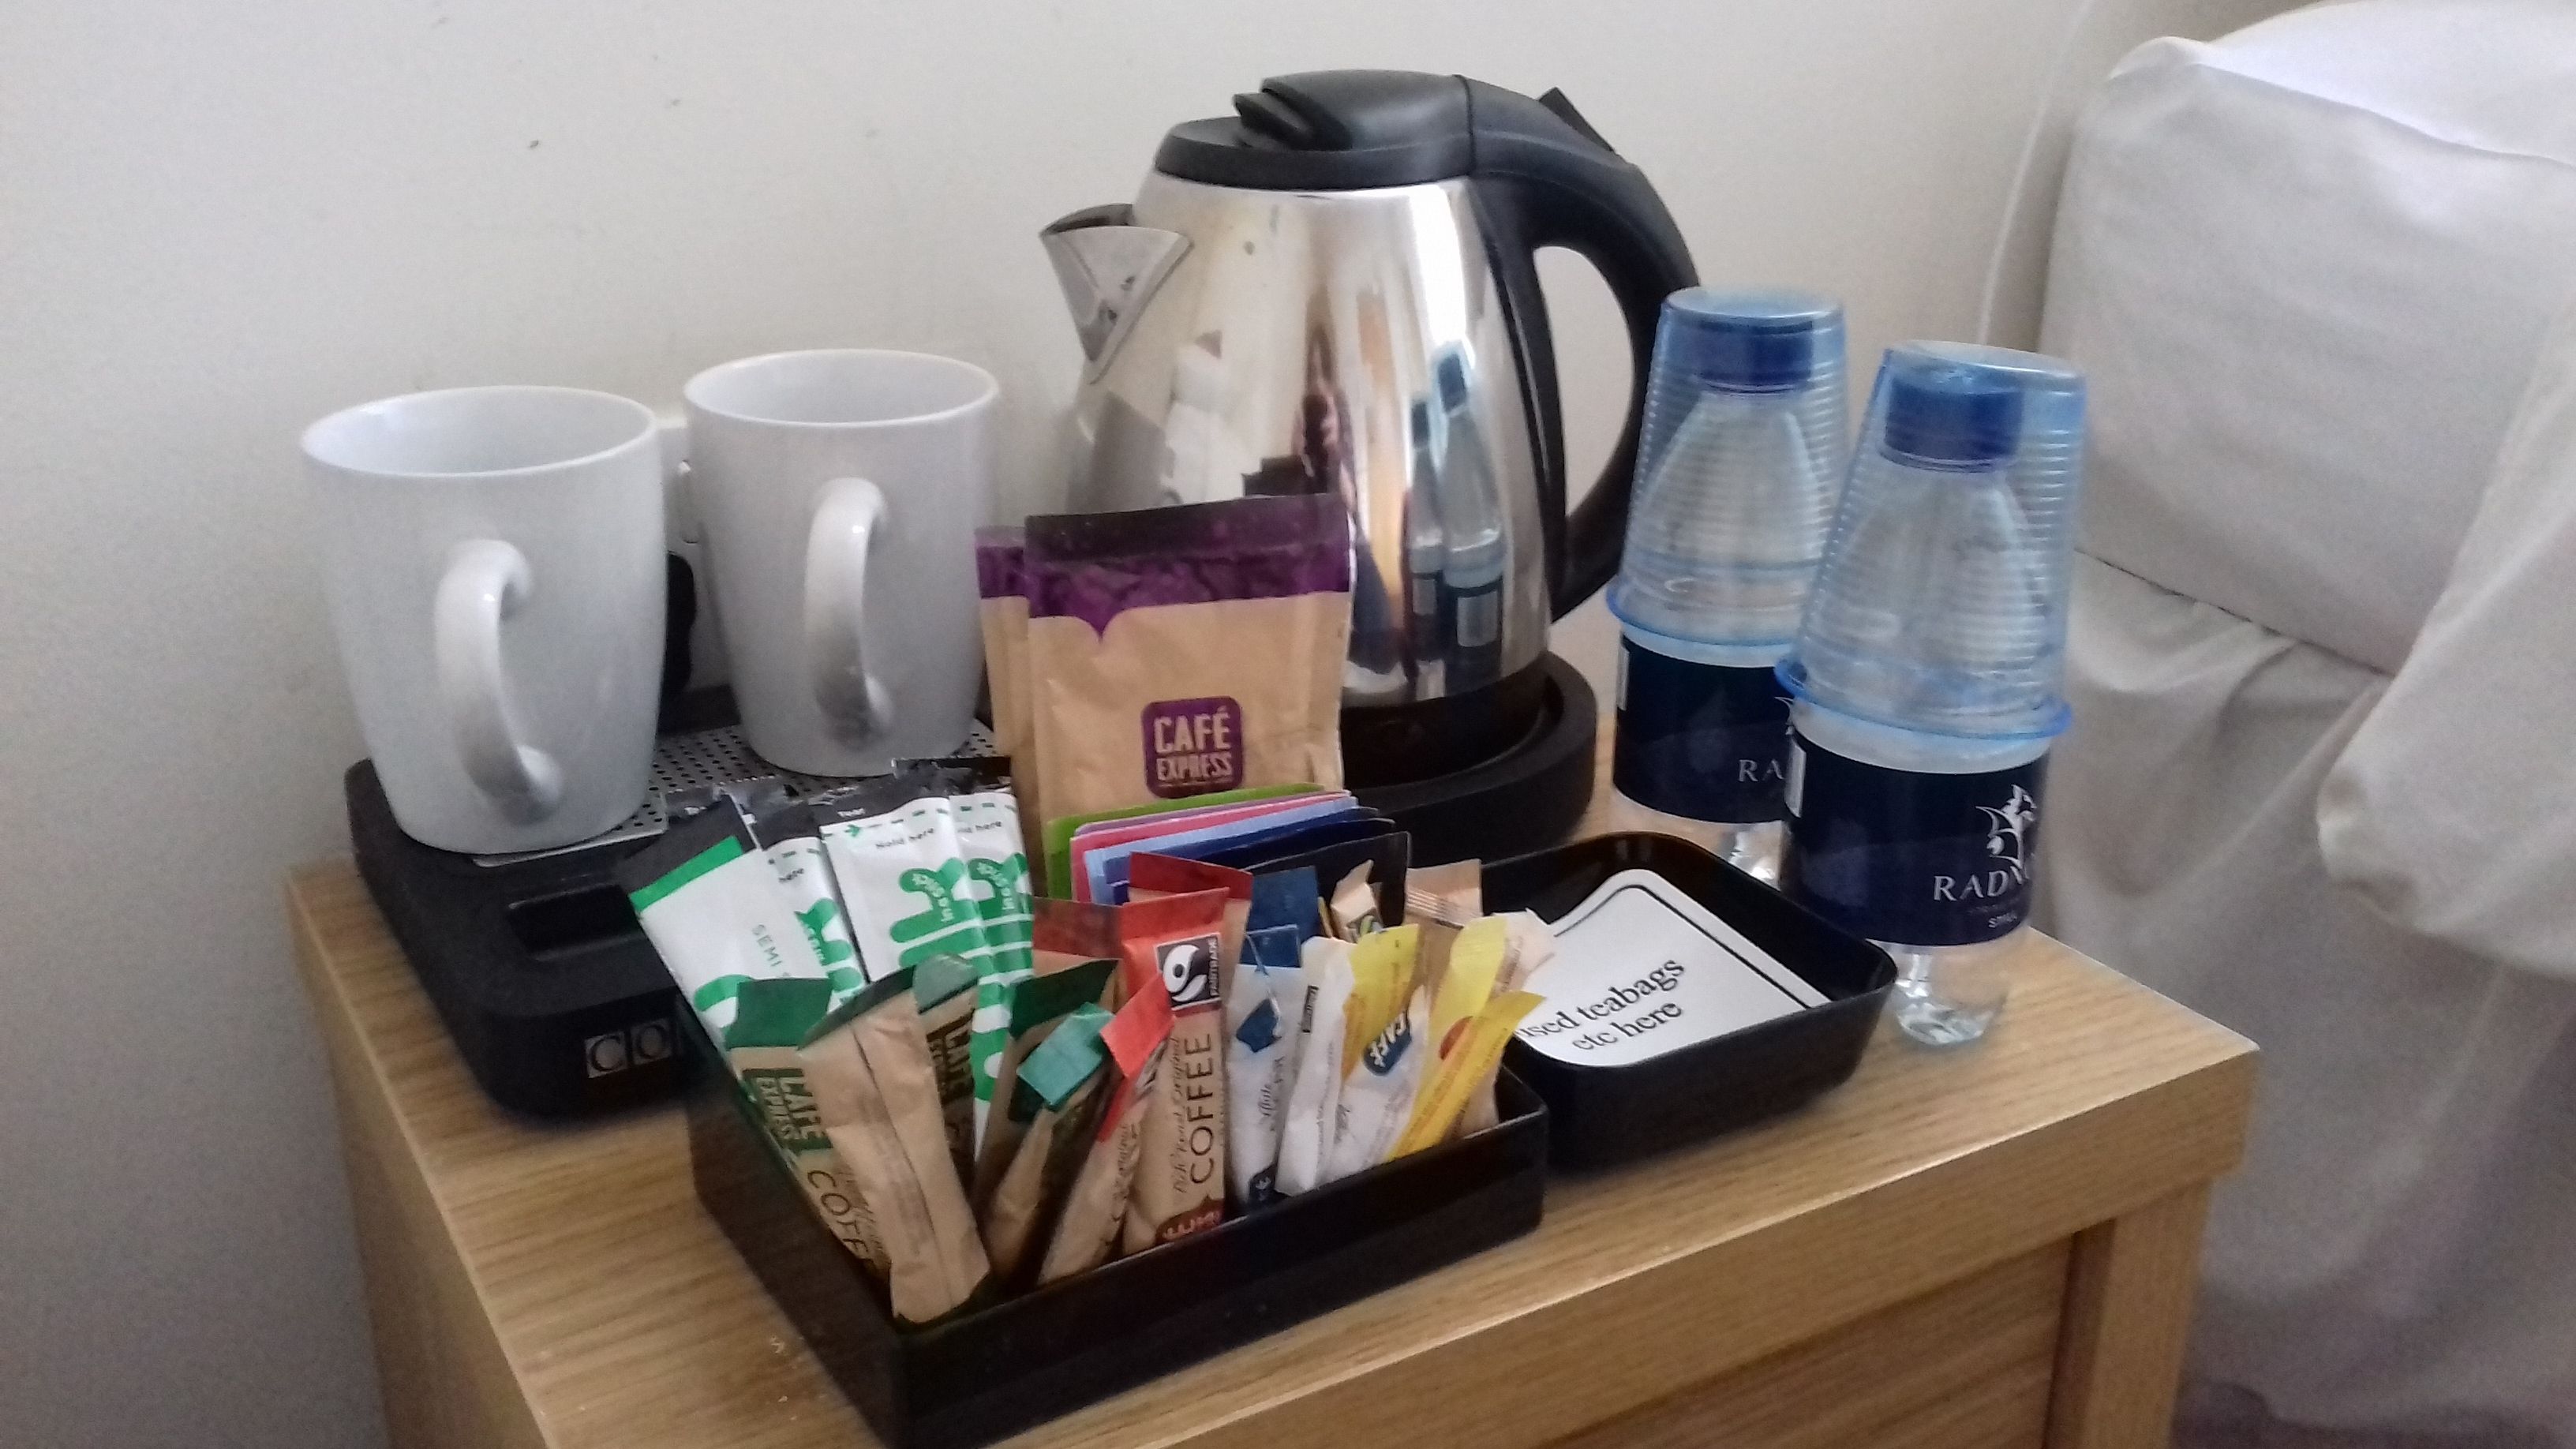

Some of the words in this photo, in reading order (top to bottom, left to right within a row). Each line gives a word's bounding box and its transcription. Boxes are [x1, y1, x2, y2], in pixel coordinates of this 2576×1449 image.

[1154, 706, 1231, 754] CAFÉ
[1156, 751, 1233, 781] EXPRESS
[751, 923, 783, 968] SEMI
[1577, 959, 1685, 1020] teabags
[1572, 1032, 1619, 1051] etc
[1609, 1002, 1683, 1038] here
[1184, 1033, 1215, 1185] COFFEE
